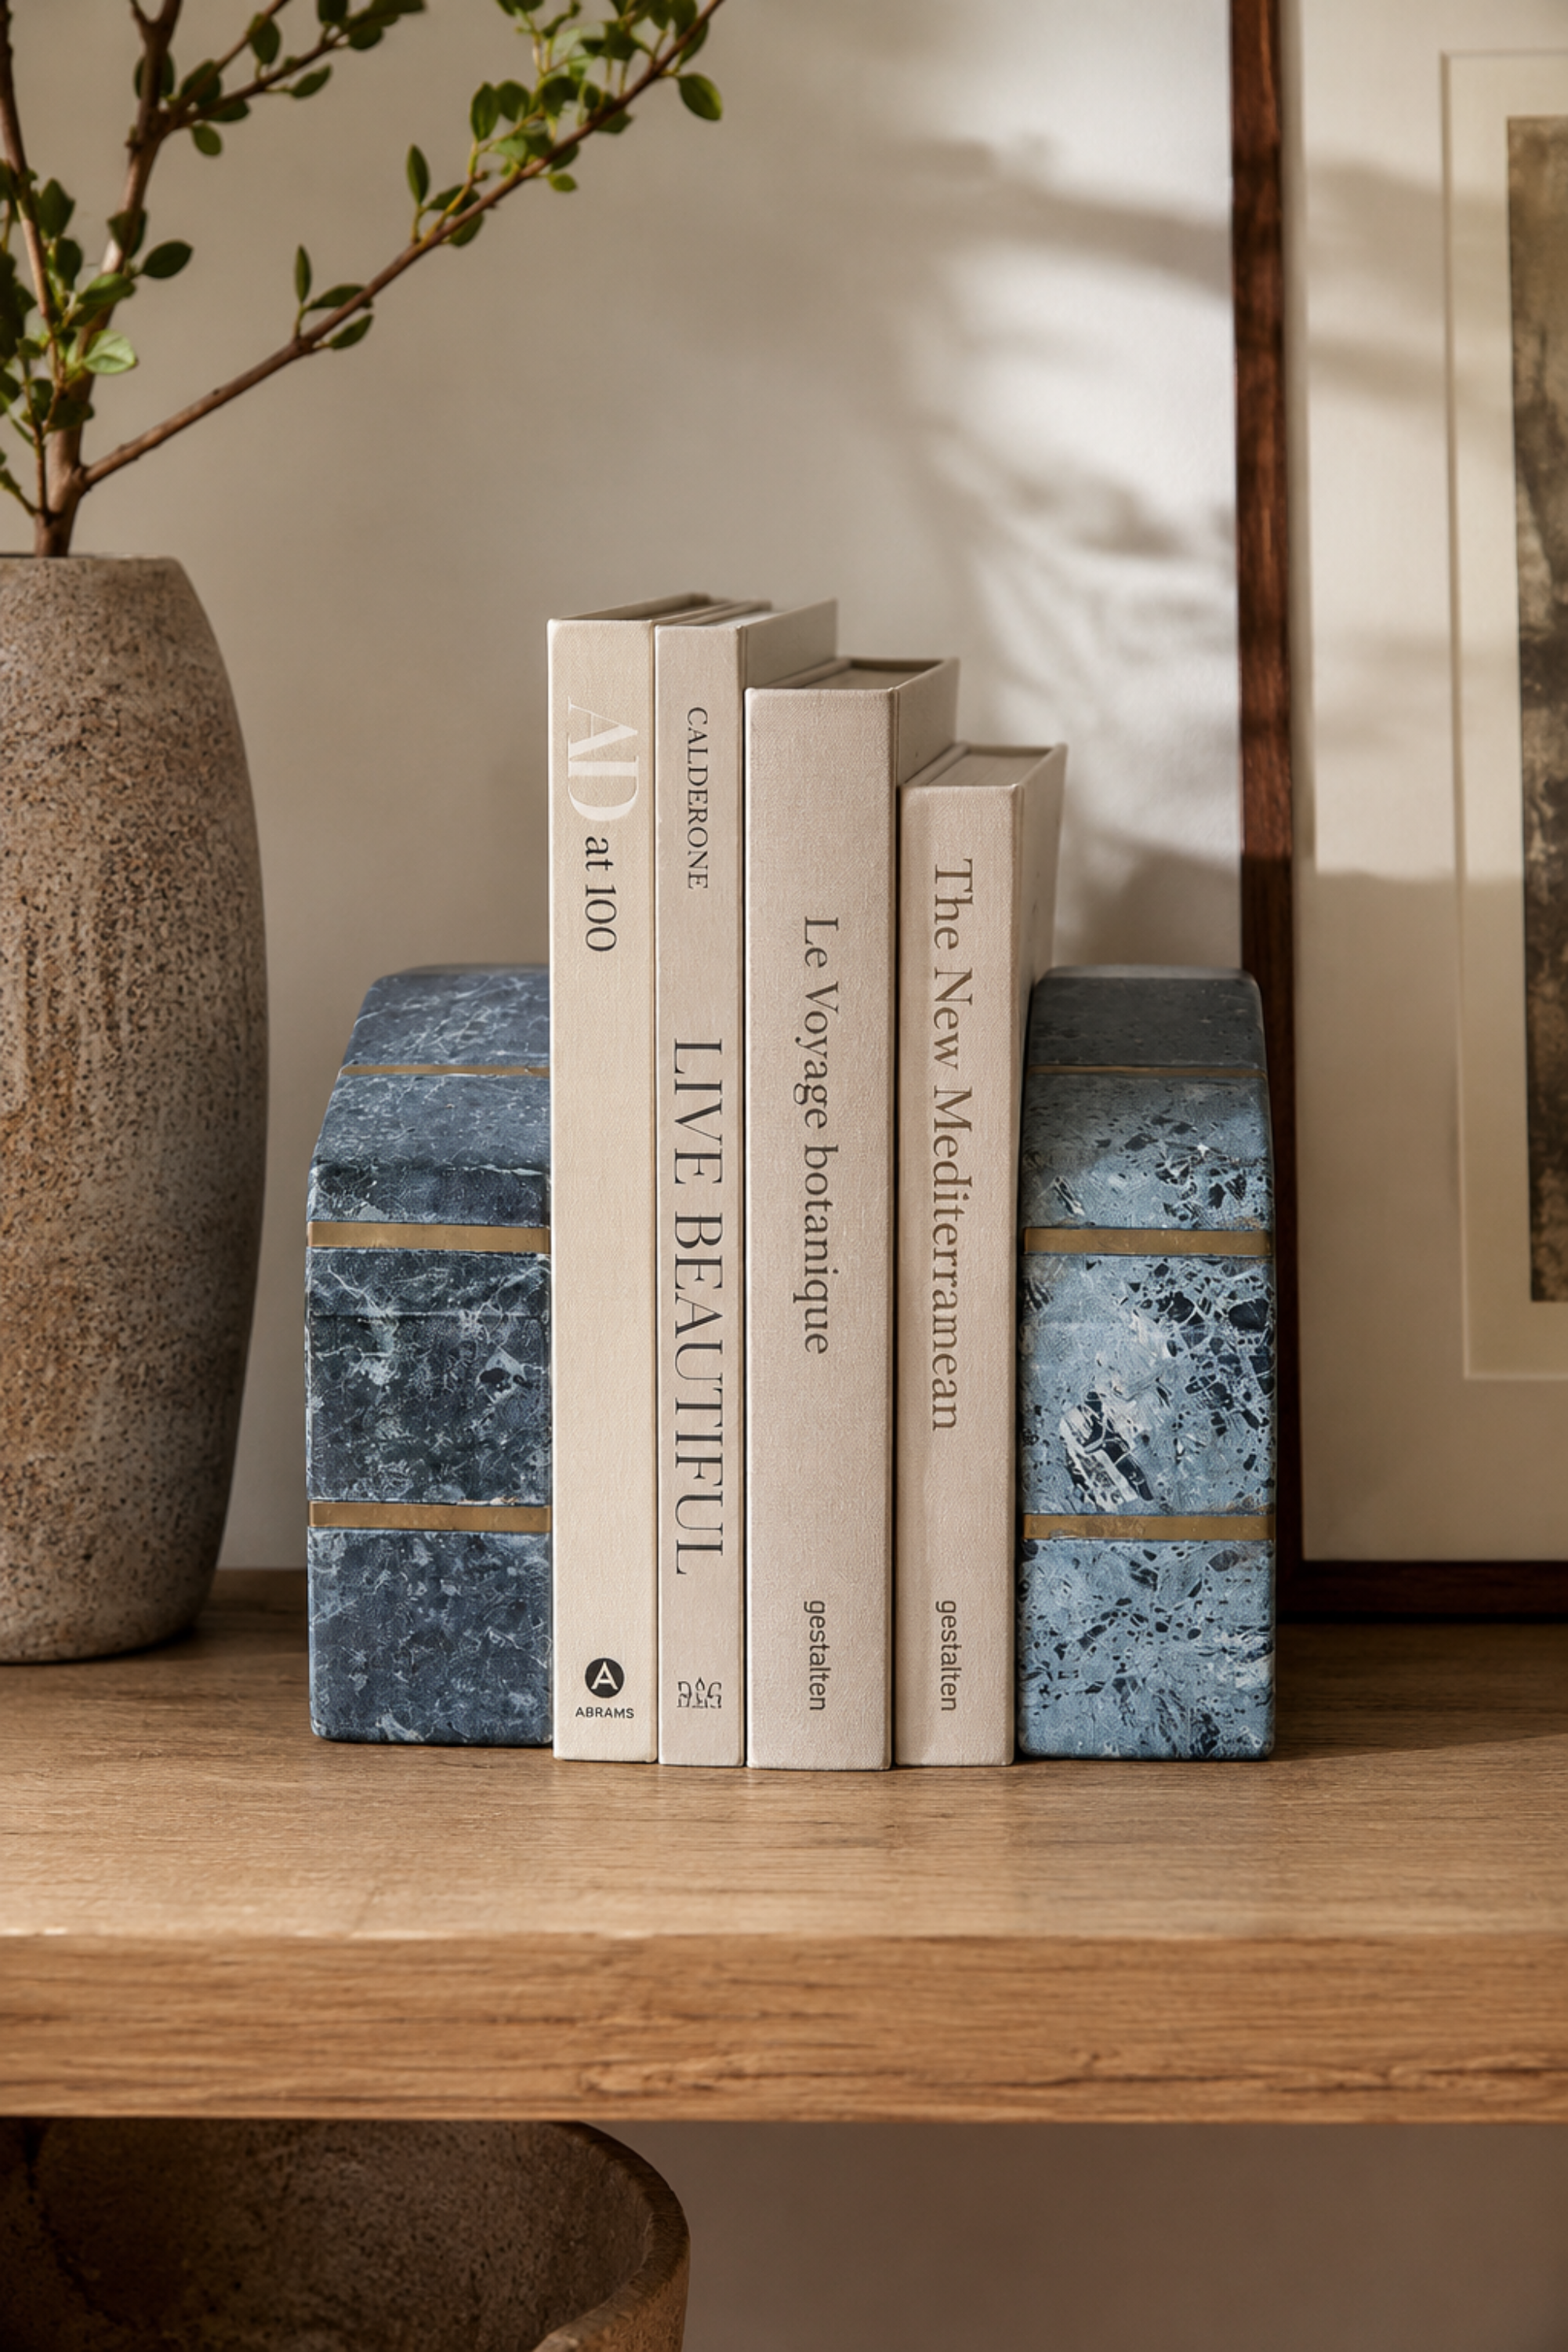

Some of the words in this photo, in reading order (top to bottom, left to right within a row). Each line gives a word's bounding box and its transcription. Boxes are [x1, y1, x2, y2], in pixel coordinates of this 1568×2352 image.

[568, 695, 639, 822] AD
[687, 706, 709, 889] CALDERONE
[584, 836, 614, 872] at
[934, 858, 973, 950] The
[584, 884, 618, 953] 100
[804, 916, 839, 968] Le
[793, 982, 839, 1129] Voyage
[933, 967, 973, 1070] New
[674, 1039, 722, 1185] LIVE
[793, 1144, 839, 1355] botanique
[674, 1211, 723, 1575] BEAUTIFUL
[590, 1660, 619, 1691] A
[804, 1600, 831, 1711] gestalten
[935, 1600, 962, 1711] gestalten
[575, 1706, 634, 1719] ABRAMS
